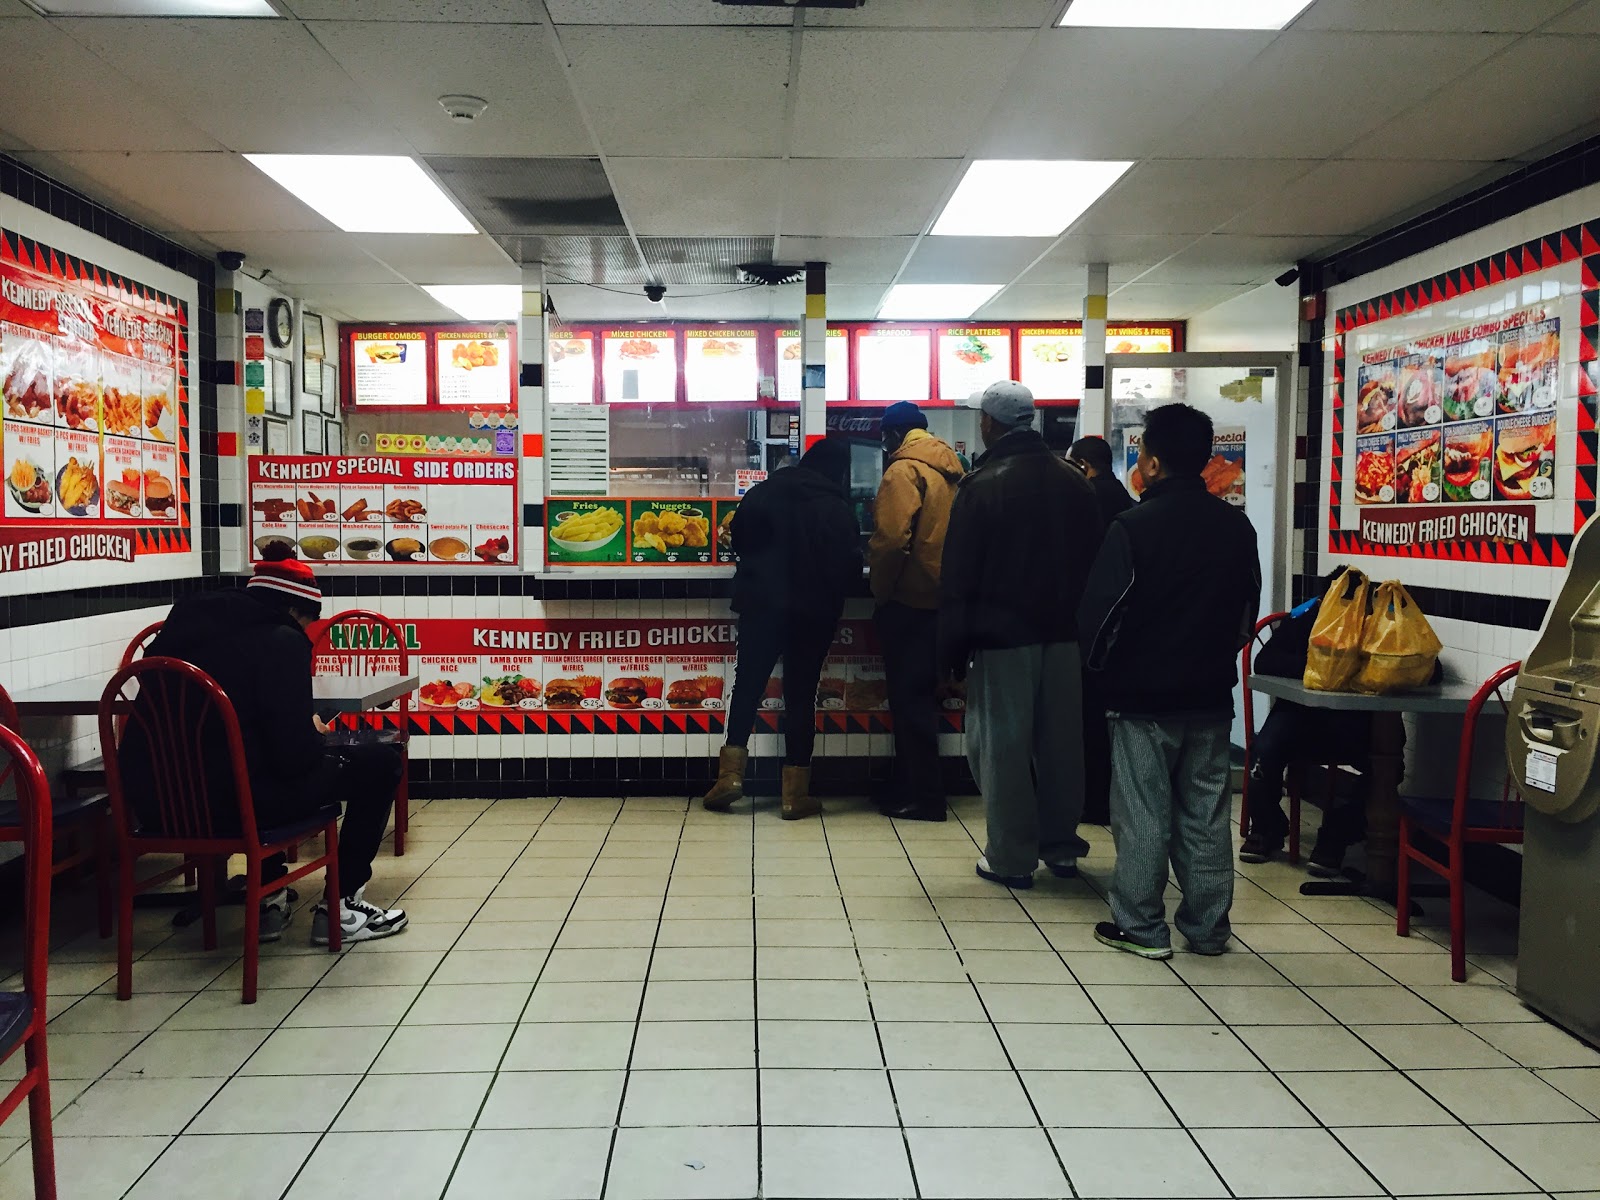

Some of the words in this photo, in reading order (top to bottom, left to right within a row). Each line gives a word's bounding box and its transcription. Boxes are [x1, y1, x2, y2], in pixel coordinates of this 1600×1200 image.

[2, 275, 51, 311] KENNEDY
[357, 332, 387, 340] BURGER
[389, 332, 422, 340] COMBOS
[1447, 326, 1470, 345] VALUE
[1472, 321, 1500, 338] COMBO
[1515, 417, 1531, 429] CHEESE
[1213, 431, 1246, 445] pecial
[259, 460, 332, 479] KENNEDY
[337, 457, 403, 477] SPECIAL
[413, 461, 449, 478] SIDE
[453, 461, 514, 479] ORDERS
[573, 502, 598, 510] Fries
[651, 502, 691, 511] Nuggets
[1363, 519, 1416, 544] KENNEDY
[1418, 515, 1456, 541] FRIED
[1459, 511, 1529, 542] CHICKEN
[19, 536, 66, 569] FRIED
[70, 533, 131, 561] CHICKEN
[473, 628, 573, 650] KENNEDY
[579, 629, 641, 650] FRIED
[647, 625, 738, 646] CHICKEN
[421, 656, 455, 664] CHICKEN
[457, 656, 477, 664] OVER
[490, 656, 511, 664] LAMB
[511, 656, 532, 664] OVER
[607, 656, 632, 664] CHEESE
[635, 656, 663, 664] BURGER
[440, 664, 458, 672] RICE
[503, 664, 520, 672] RICE
[704, 700, 721, 708] 4.50
